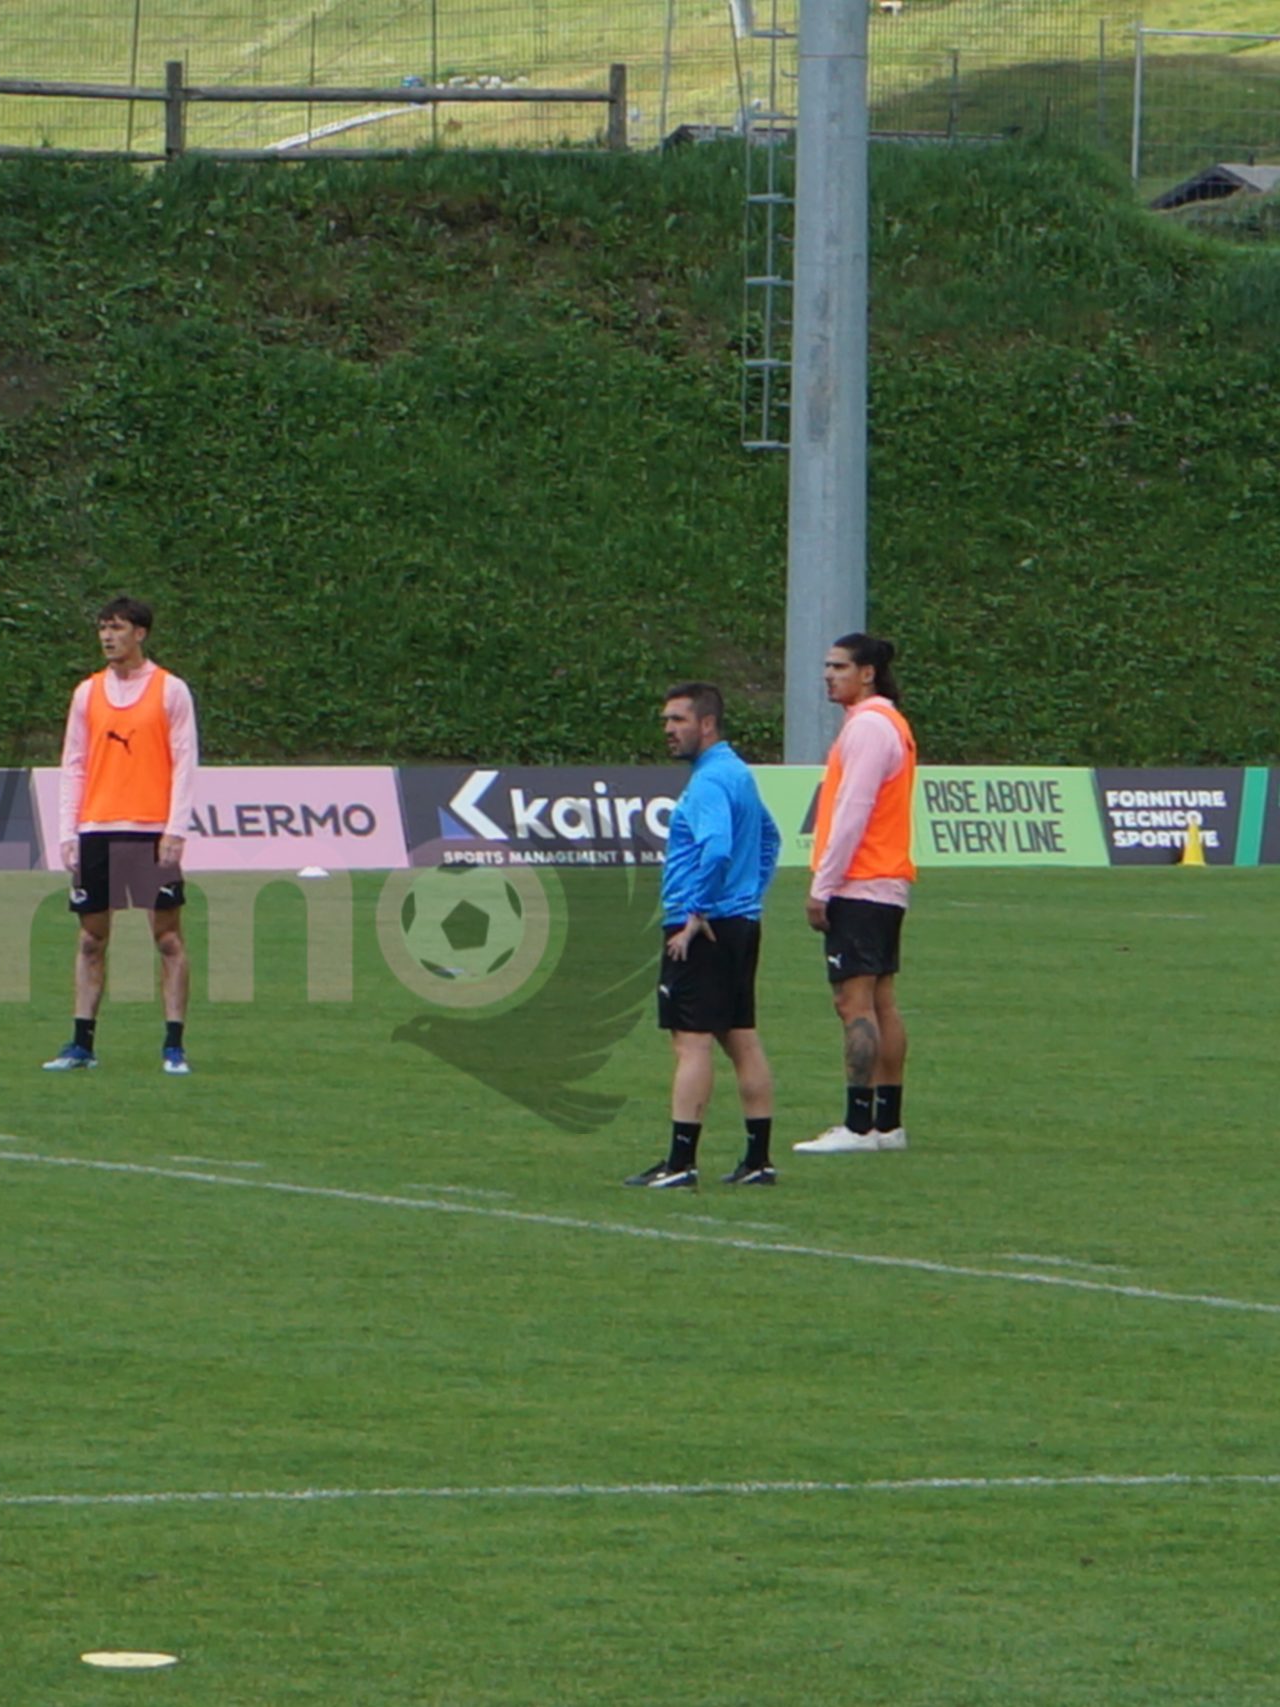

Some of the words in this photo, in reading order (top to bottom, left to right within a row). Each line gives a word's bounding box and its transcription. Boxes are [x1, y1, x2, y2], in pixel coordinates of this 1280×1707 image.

[923, 780, 980, 813] RISE
[985, 780, 1064, 813] ABOVE
[1105, 791, 1227, 808] FORNITURE
[188, 803, 376, 837] ALERMO
[1109, 810, 1203, 828] TECNICO
[931, 820, 1008, 852] EVERY
[1013, 820, 1066, 852] LINE
[443, 851, 504, 864] SPORTS
[509, 851, 617, 864] MANAGEMENT
